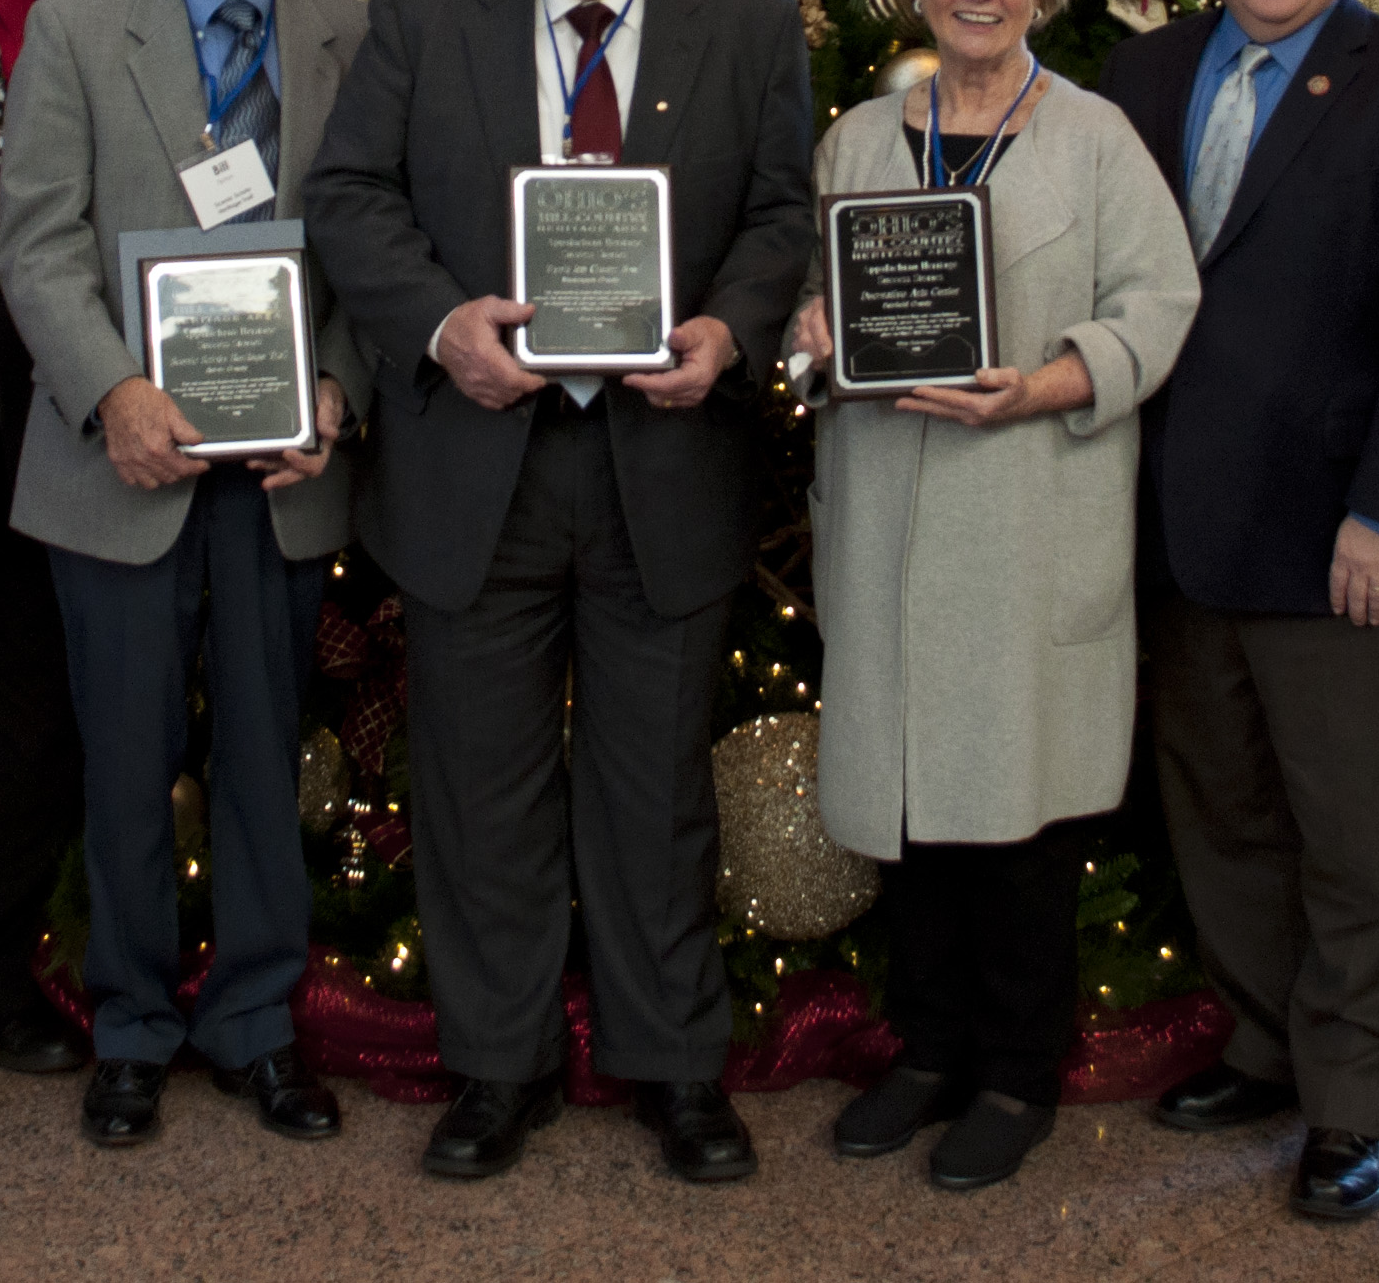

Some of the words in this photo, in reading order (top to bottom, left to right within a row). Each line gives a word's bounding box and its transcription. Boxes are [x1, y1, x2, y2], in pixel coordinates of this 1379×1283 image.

[211, 159, 230, 176] Bill
[851, 211, 964, 236] OHIO'S
[851, 249, 922, 261] HERITAGE
[927, 246, 964, 256] AREA
[862, 263, 919, 275] Appalachian
